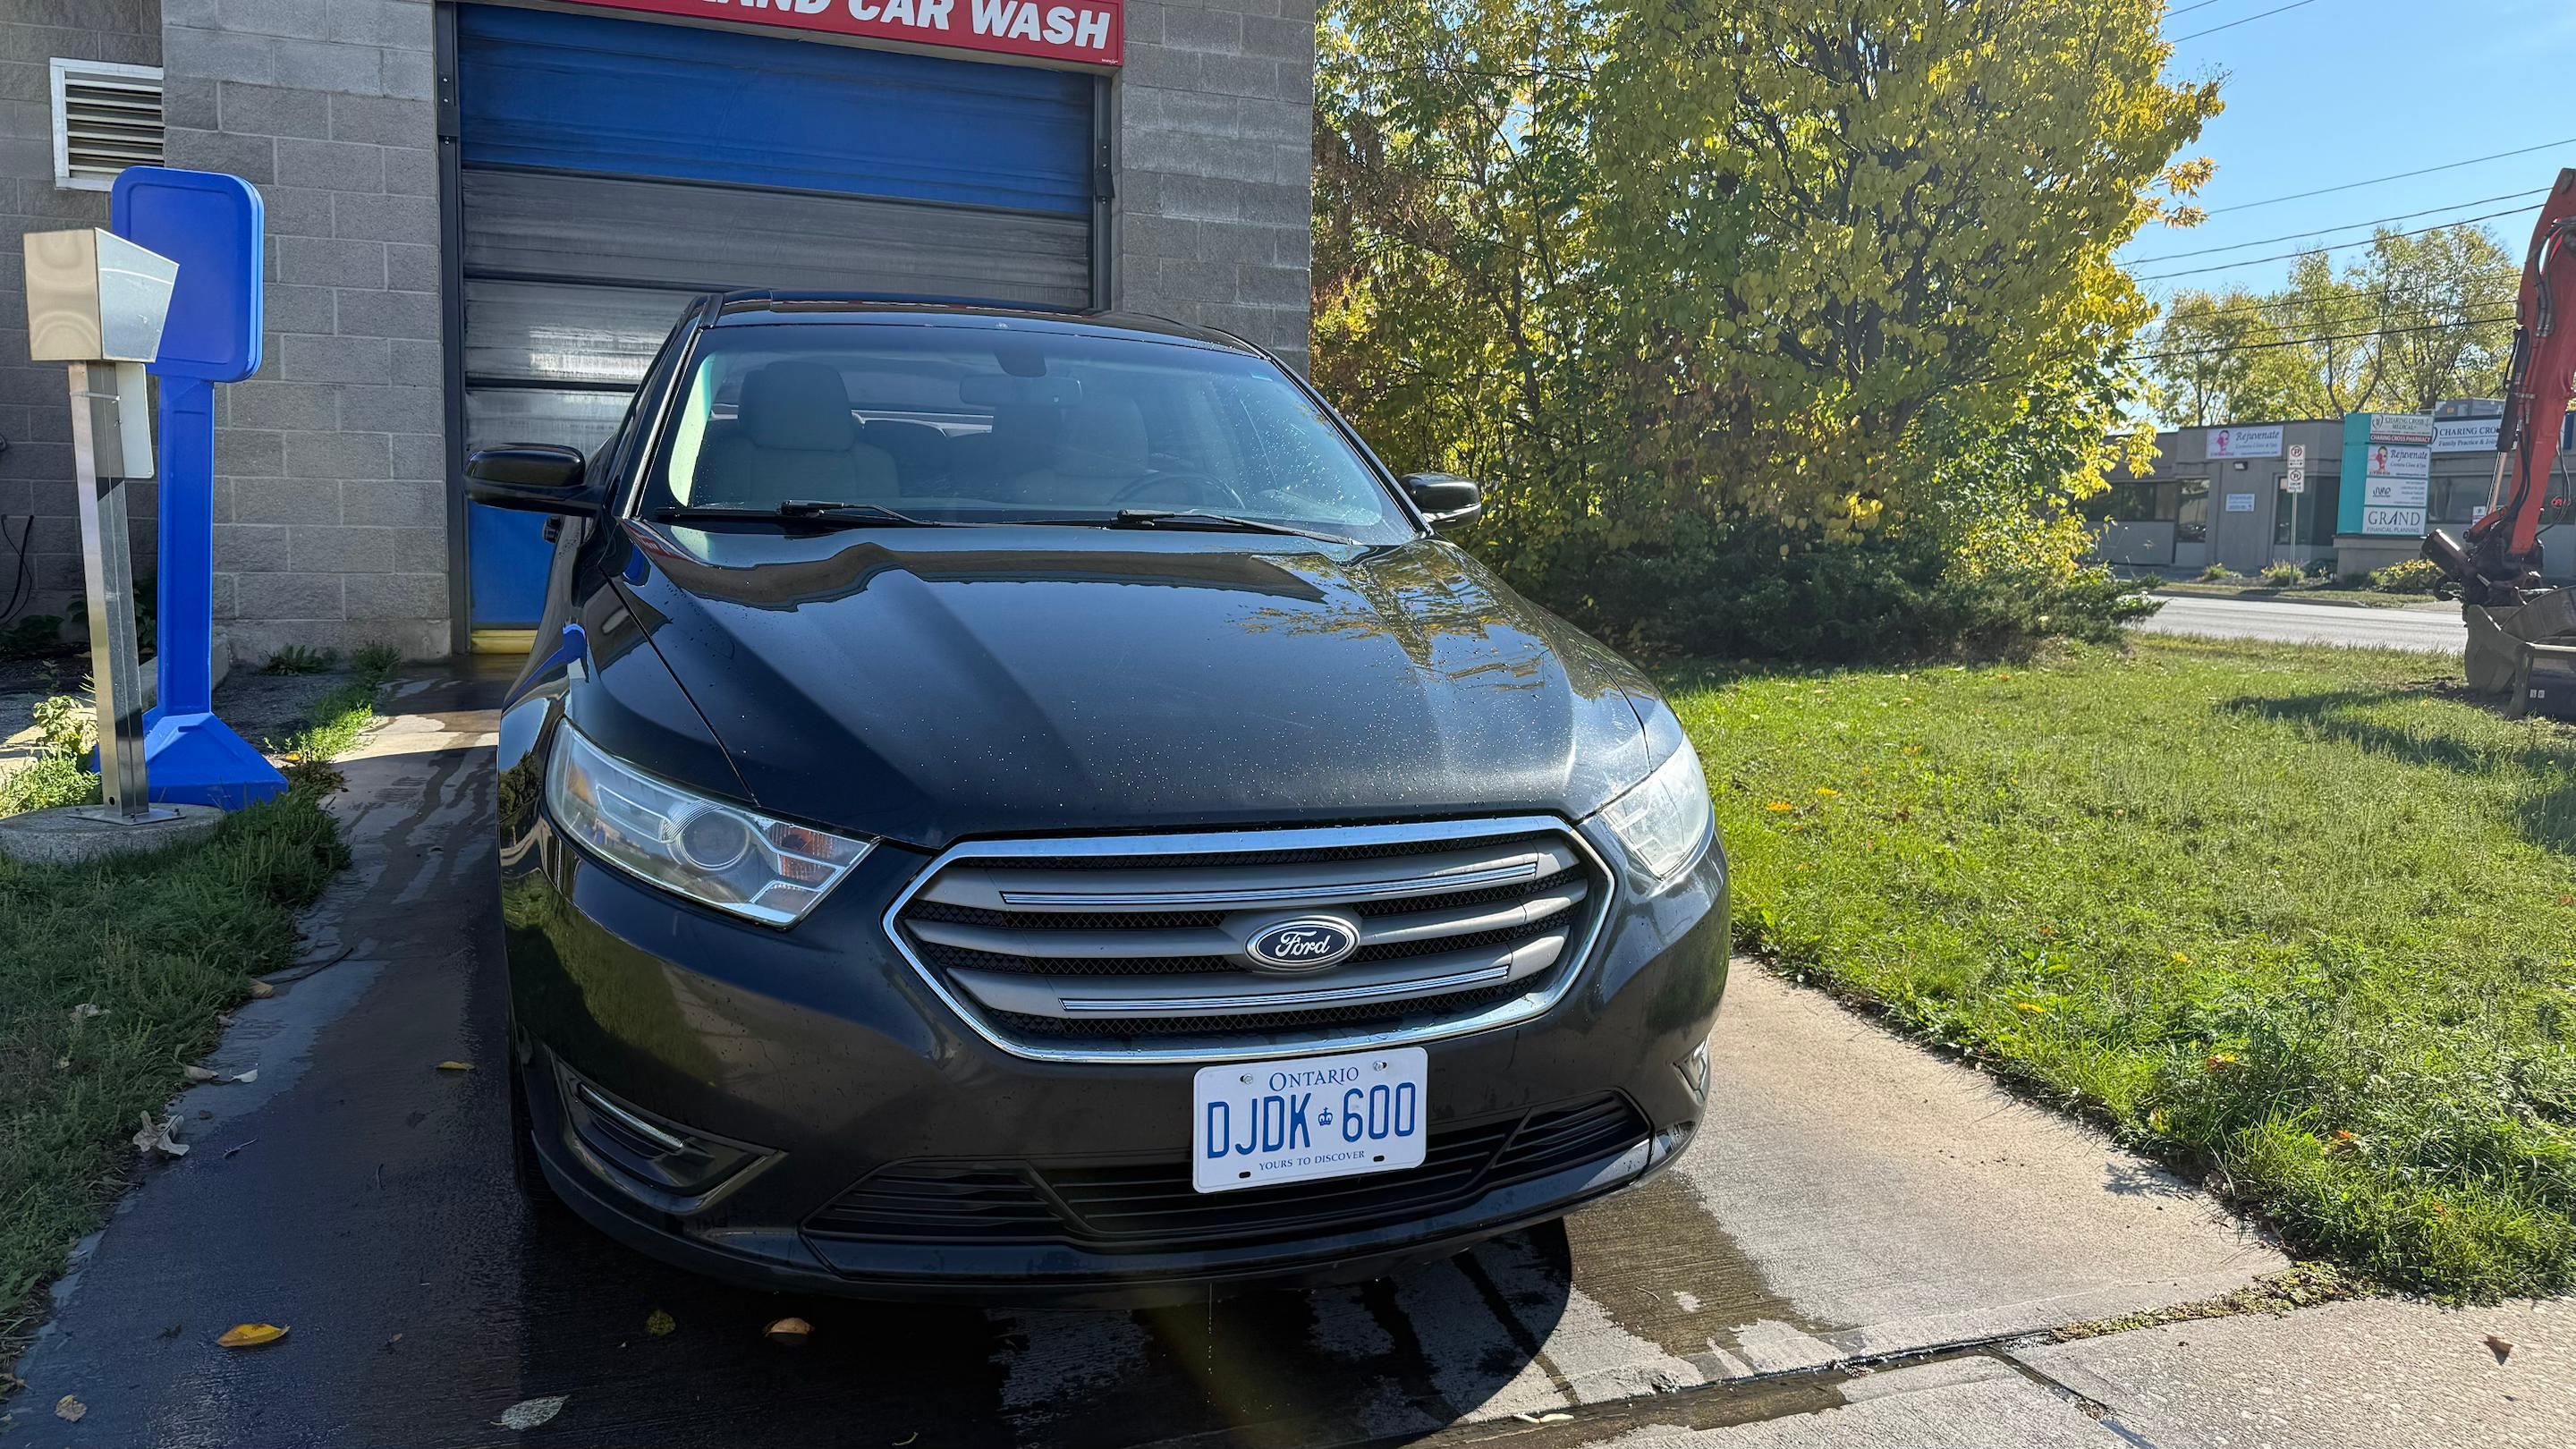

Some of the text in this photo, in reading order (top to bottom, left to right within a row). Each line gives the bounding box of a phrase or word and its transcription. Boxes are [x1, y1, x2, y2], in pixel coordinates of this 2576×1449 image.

[848, 0, 1111, 49] CAR WASH
[2235, 429, 2280, 444] Rejuvenate
[2439, 428, 2478, 436] CHARING
[2479, 426, 2497, 435] CRO
[2390, 449, 2428, 462] Rejuvenate
[2368, 510, 2420, 526] GRAND
[1275, 930, 1332, 957] Ford
[1268, 1066, 1360, 1092] ONTARIO
[1207, 1081, 1417, 1159] DJDK 600
[1258, 1150, 1365, 1171] YOURS TO DISCOVER
